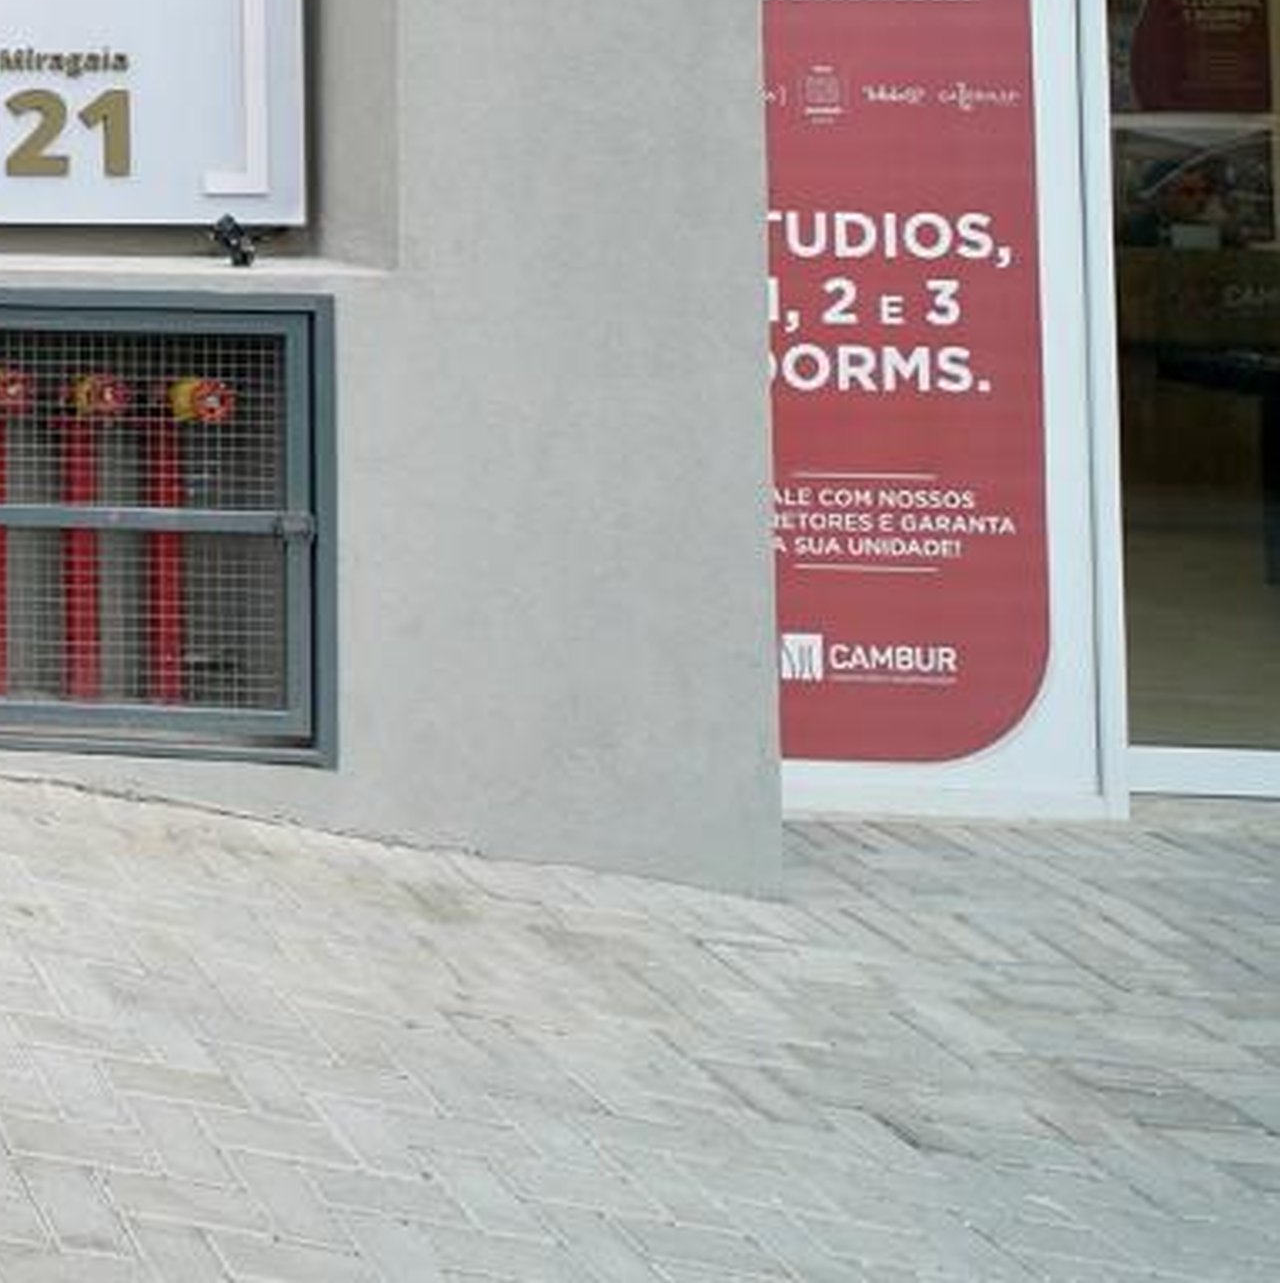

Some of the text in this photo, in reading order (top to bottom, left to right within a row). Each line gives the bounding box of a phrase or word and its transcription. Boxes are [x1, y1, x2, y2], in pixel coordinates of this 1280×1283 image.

[821, 276, 859, 325] 2
[879, 294, 906, 325] E
[924, 278, 962, 327] 3
[768, 342, 992, 393] ORMS.
[817, 488, 873, 509] COM
[878, 490, 976, 510] NOSSOS
[878, 513, 895, 533] E
[901, 515, 1017, 536] GARANTA
[793, 536, 842, 556] SUA
[847, 537, 963, 558] UNIDADE!
[829, 643, 958, 672] CAMBUR
